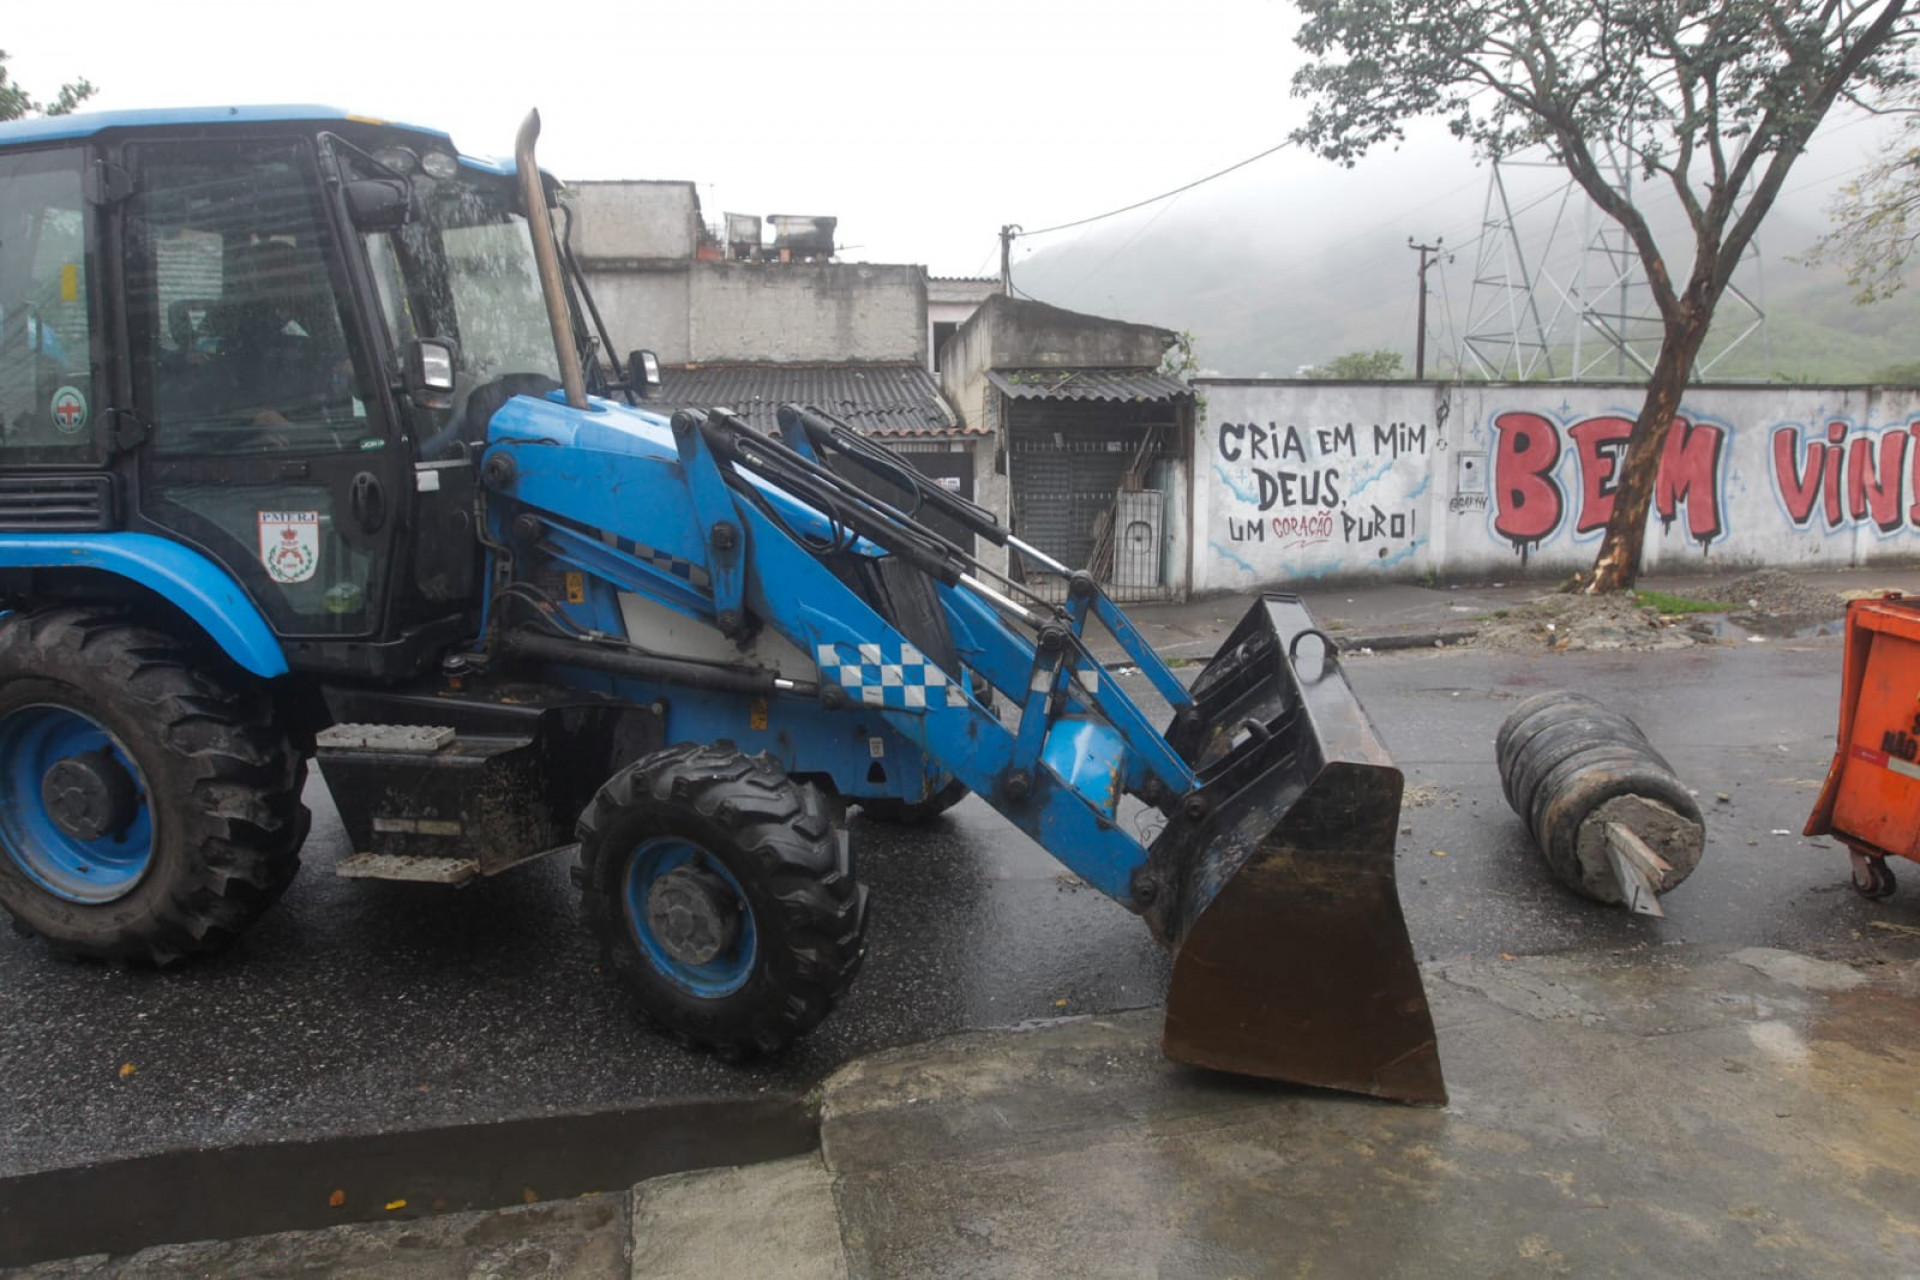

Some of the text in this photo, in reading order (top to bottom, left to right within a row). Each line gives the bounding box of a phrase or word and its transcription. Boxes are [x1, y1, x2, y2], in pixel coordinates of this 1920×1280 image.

[1317, 422, 1356, 457] EM
[1494, 411, 1920, 541] BEM ViN
[1228, 515, 1264, 542] UM
[1340, 504, 1416, 547] PURO!
